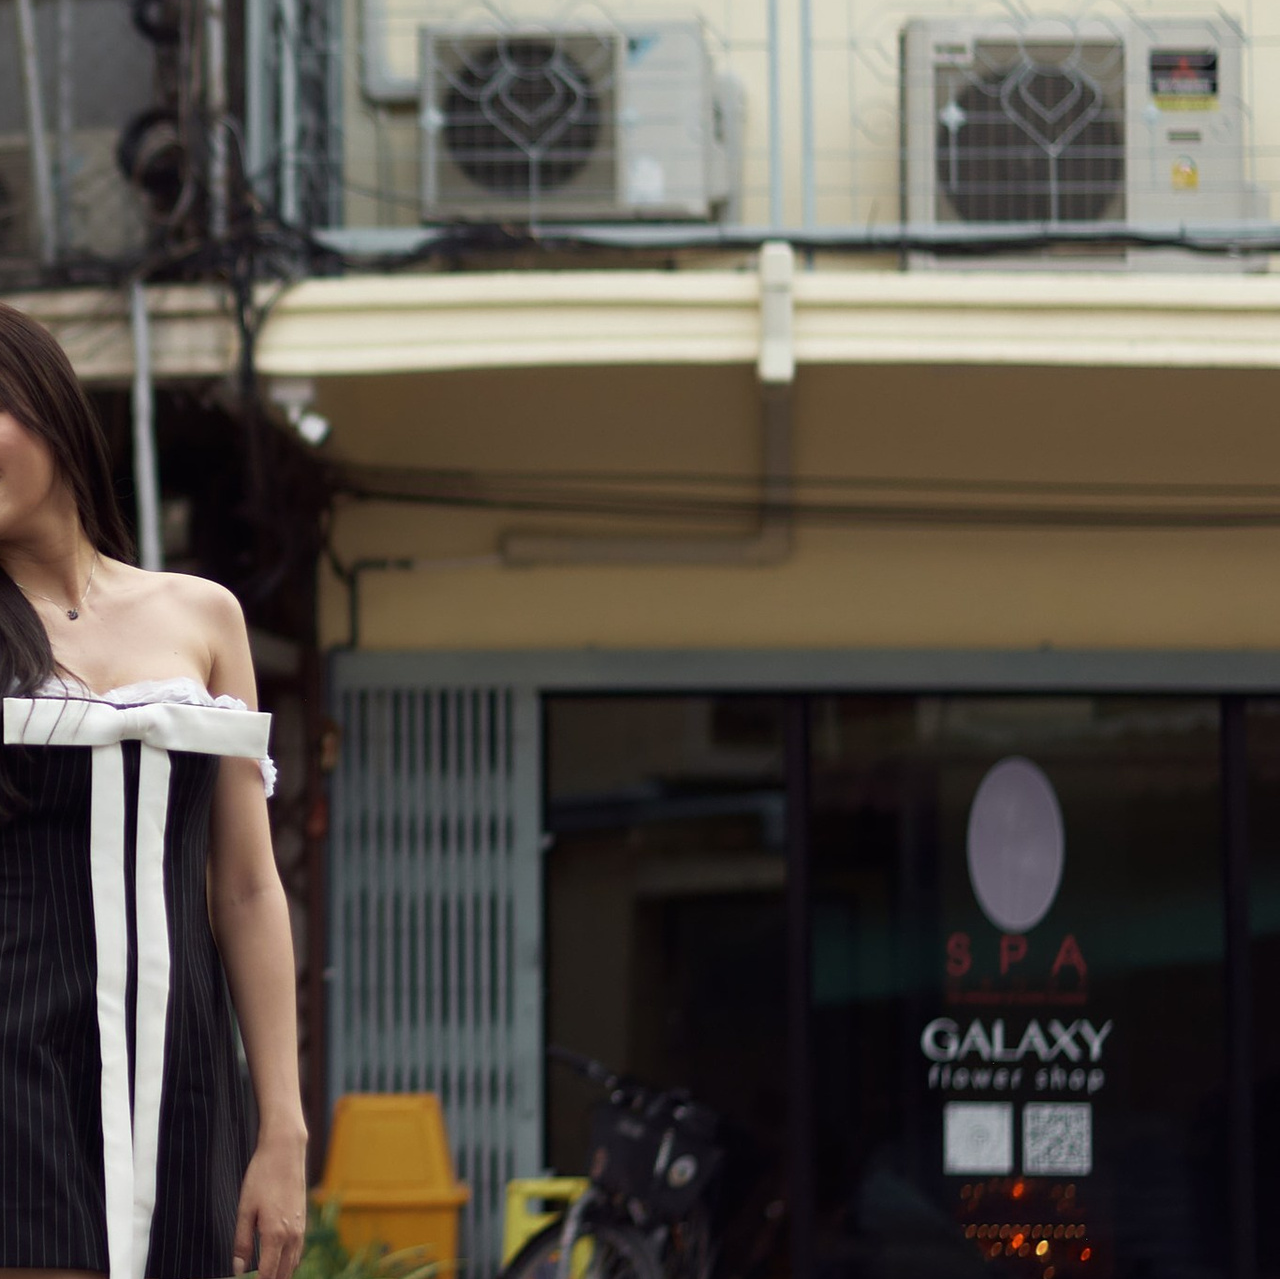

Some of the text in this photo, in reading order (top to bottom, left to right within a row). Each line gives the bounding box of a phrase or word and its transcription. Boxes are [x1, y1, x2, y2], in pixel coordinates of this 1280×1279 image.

[920, 1016, 1114, 1063] GALAXY
[927, 1063, 1106, 1095] flower shop
